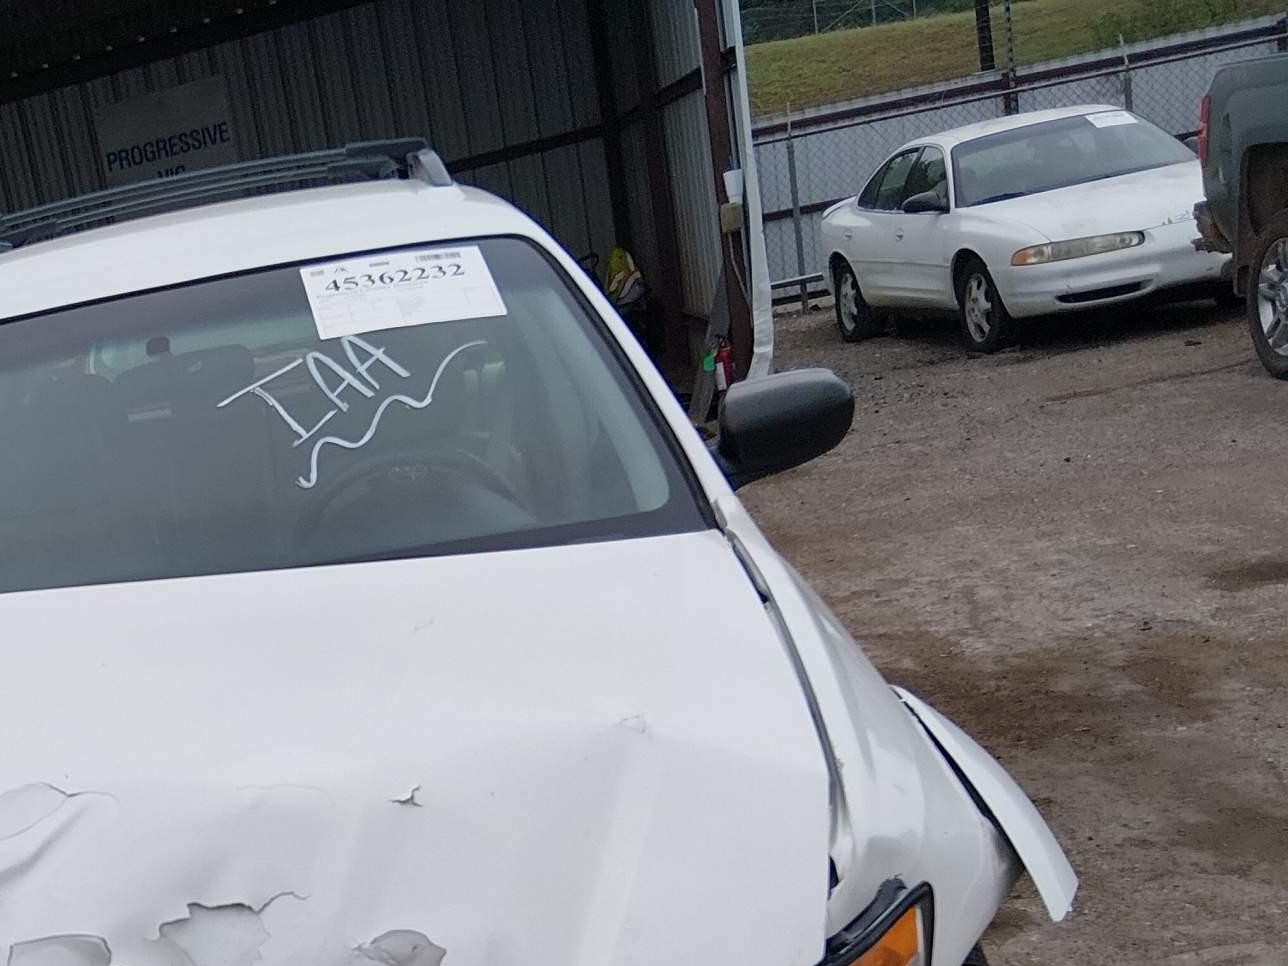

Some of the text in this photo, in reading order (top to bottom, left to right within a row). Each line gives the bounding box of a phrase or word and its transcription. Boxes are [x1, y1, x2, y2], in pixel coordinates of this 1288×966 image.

[106, 121, 230, 172] PROGRESSIVE
[325, 263, 466, 291] 45362232
[216, 335, 411, 448] IAA
